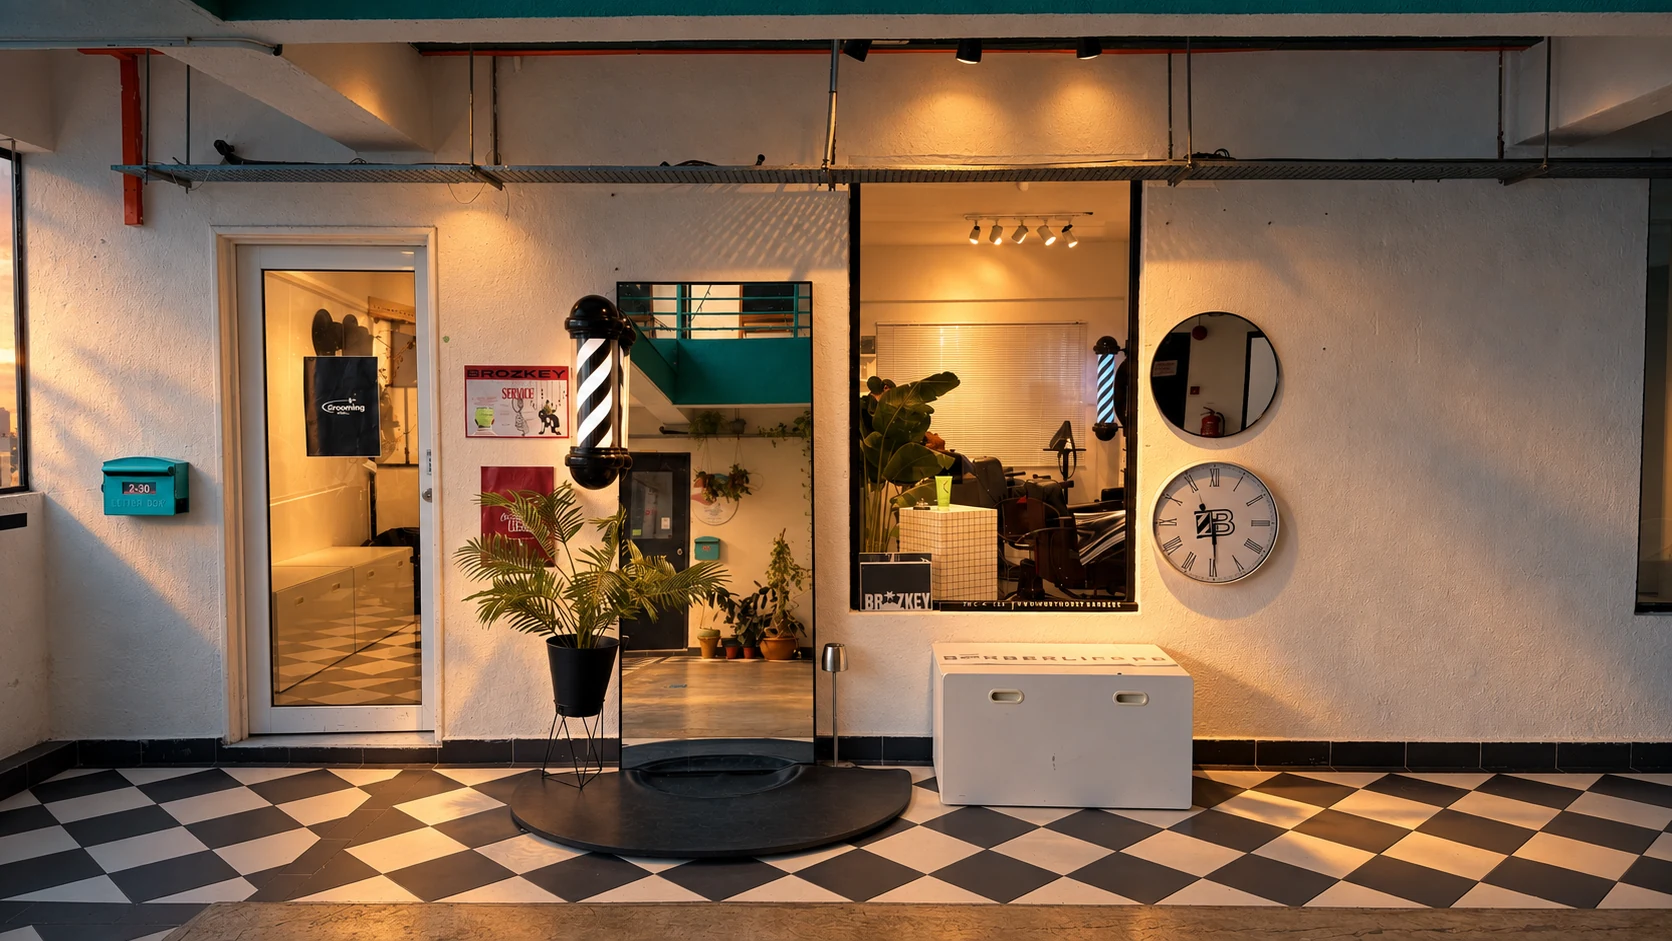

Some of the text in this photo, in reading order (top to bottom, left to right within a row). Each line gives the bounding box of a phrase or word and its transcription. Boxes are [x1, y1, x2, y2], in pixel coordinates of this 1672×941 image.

[467, 369, 566, 379] BROZKEY
[501, 387, 535, 400] SERVICE
[327, 403, 366, 413] Grooming
[128, 483, 151, 494] 2-30
